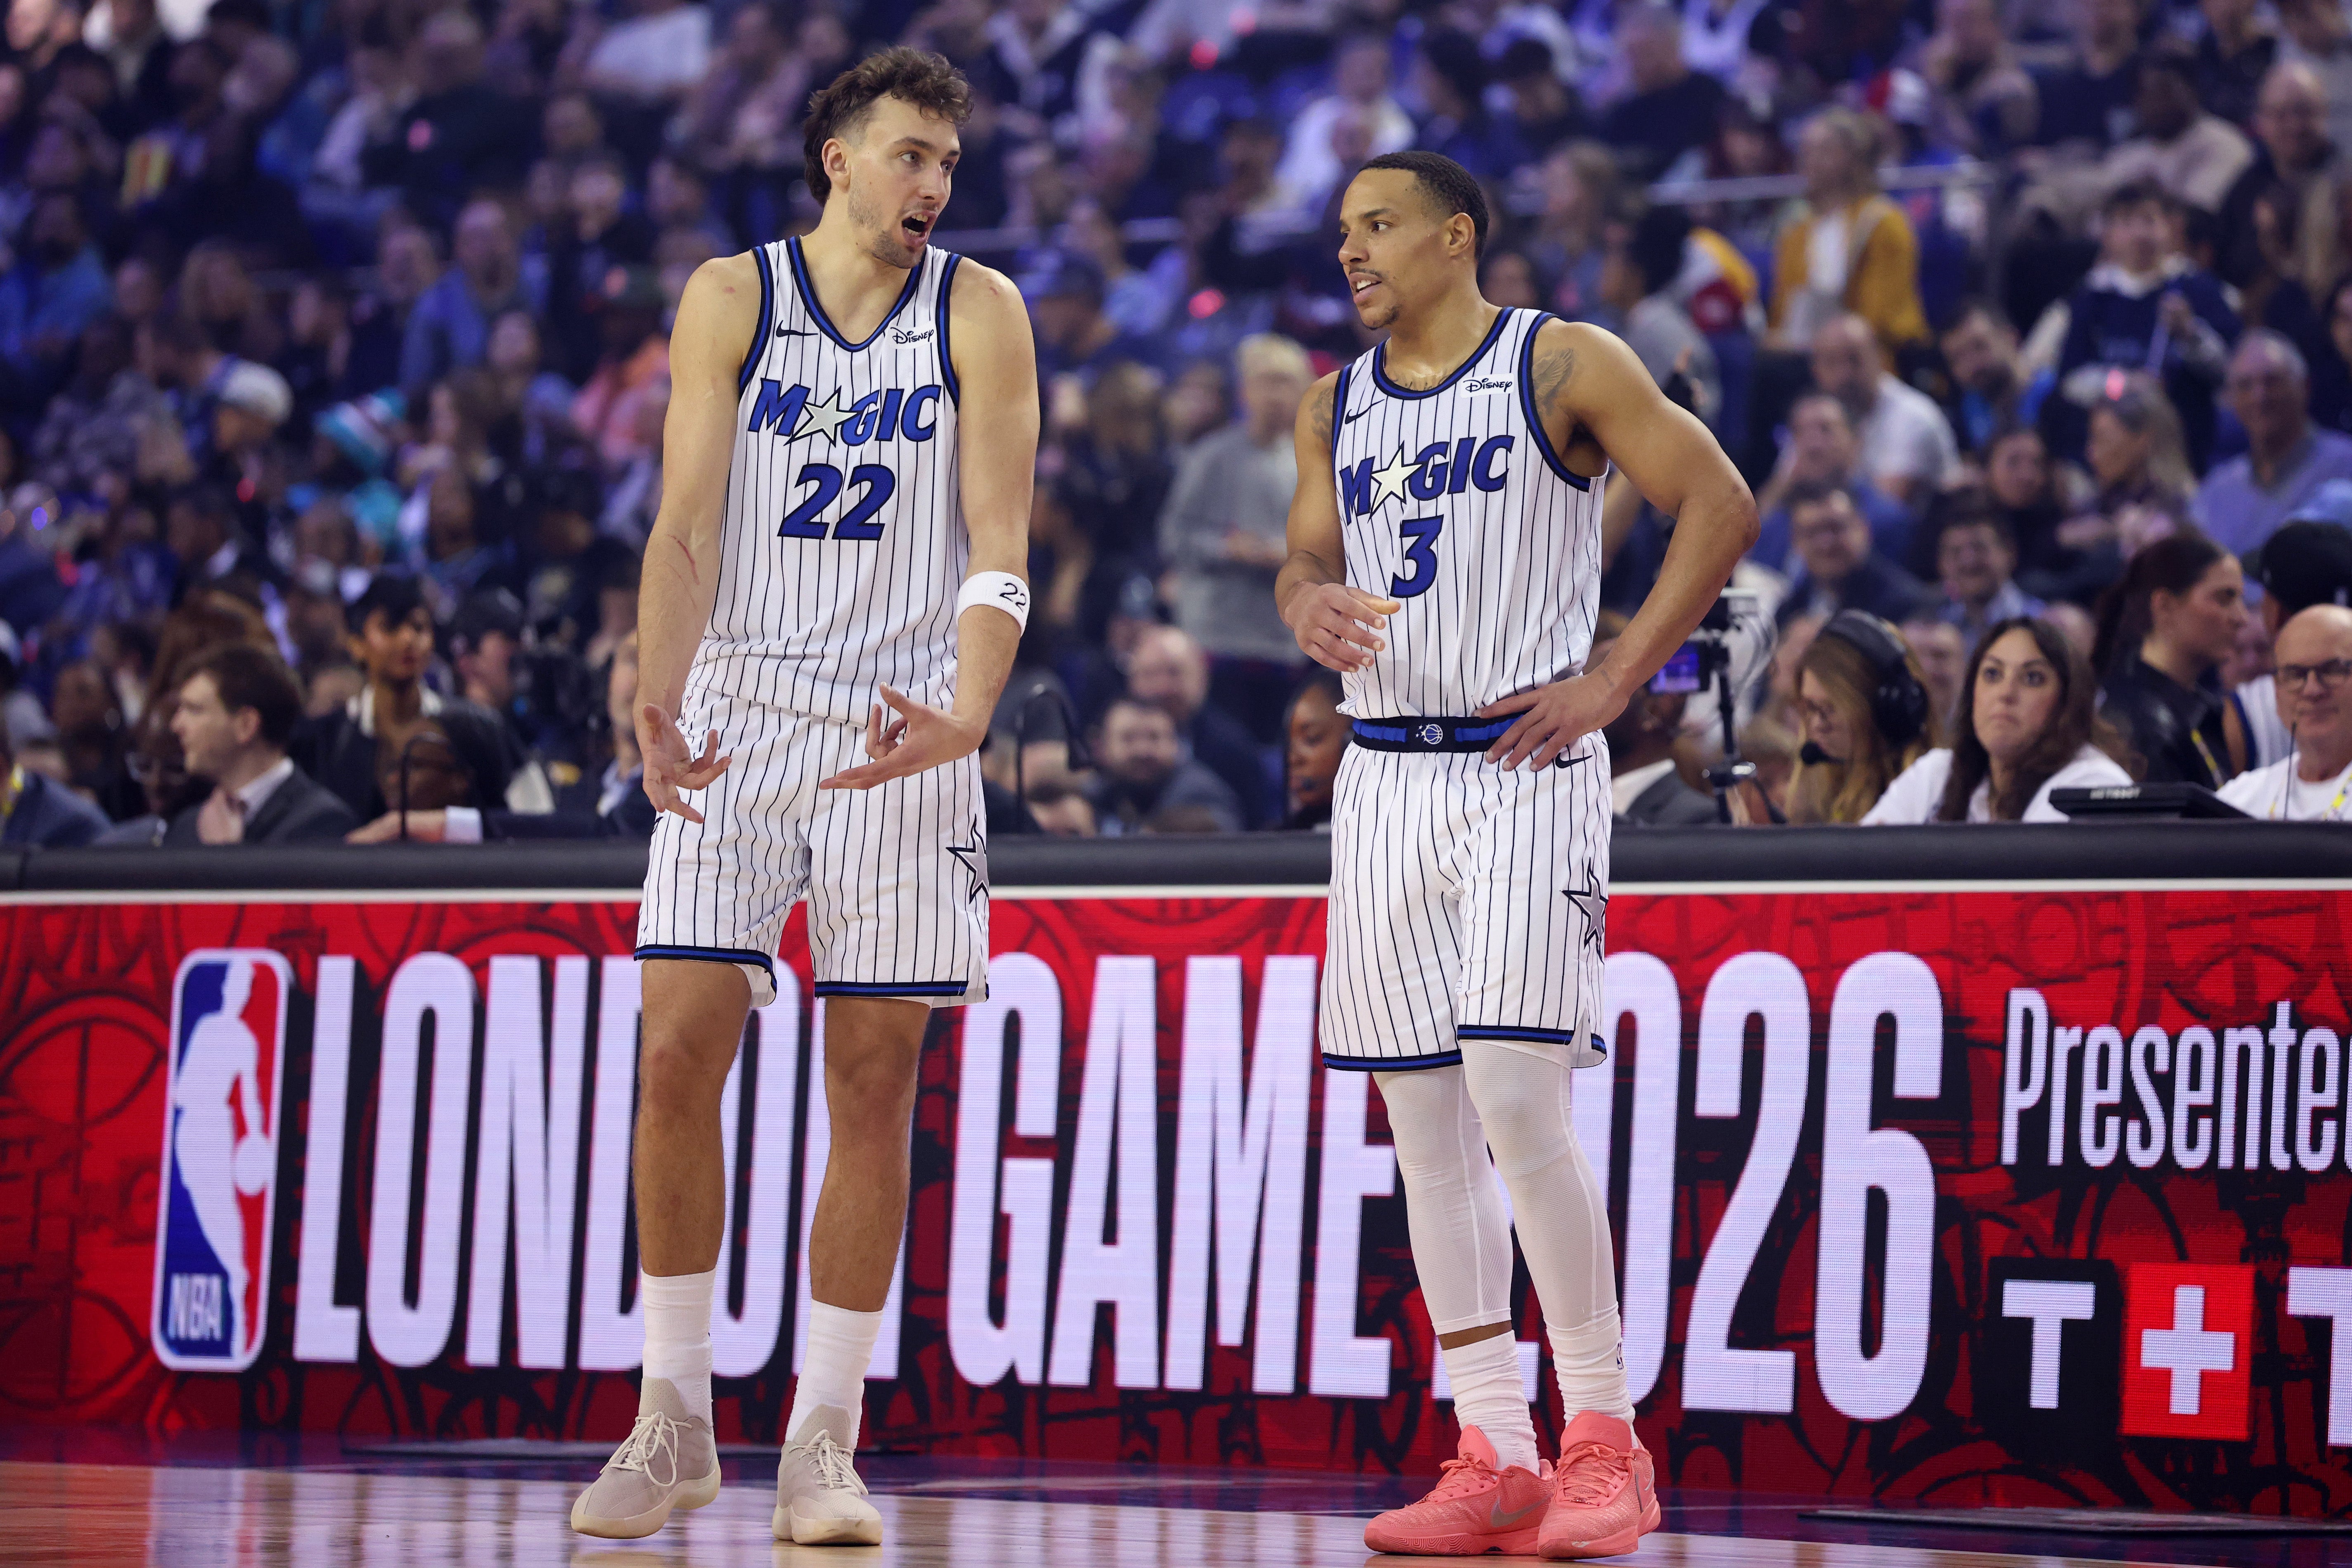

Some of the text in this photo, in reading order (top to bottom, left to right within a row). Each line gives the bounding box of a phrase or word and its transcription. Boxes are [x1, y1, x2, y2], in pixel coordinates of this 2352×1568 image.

[891, 327, 934, 345] Disney
[748, 377, 942, 446] MGIC
[1463, 378, 1513, 393] Disney
[777, 463, 896, 541] 22
[1339, 435, 1515, 526] MGIC
[1390, 514, 1444, 598] 3
[999, 583, 1026, 613] 22
[2001, 988, 2352, 1171] Presente
[293, 950, 1944, 1420] LONDO GAME 026
[168, 1273, 222, 1341] NBA
